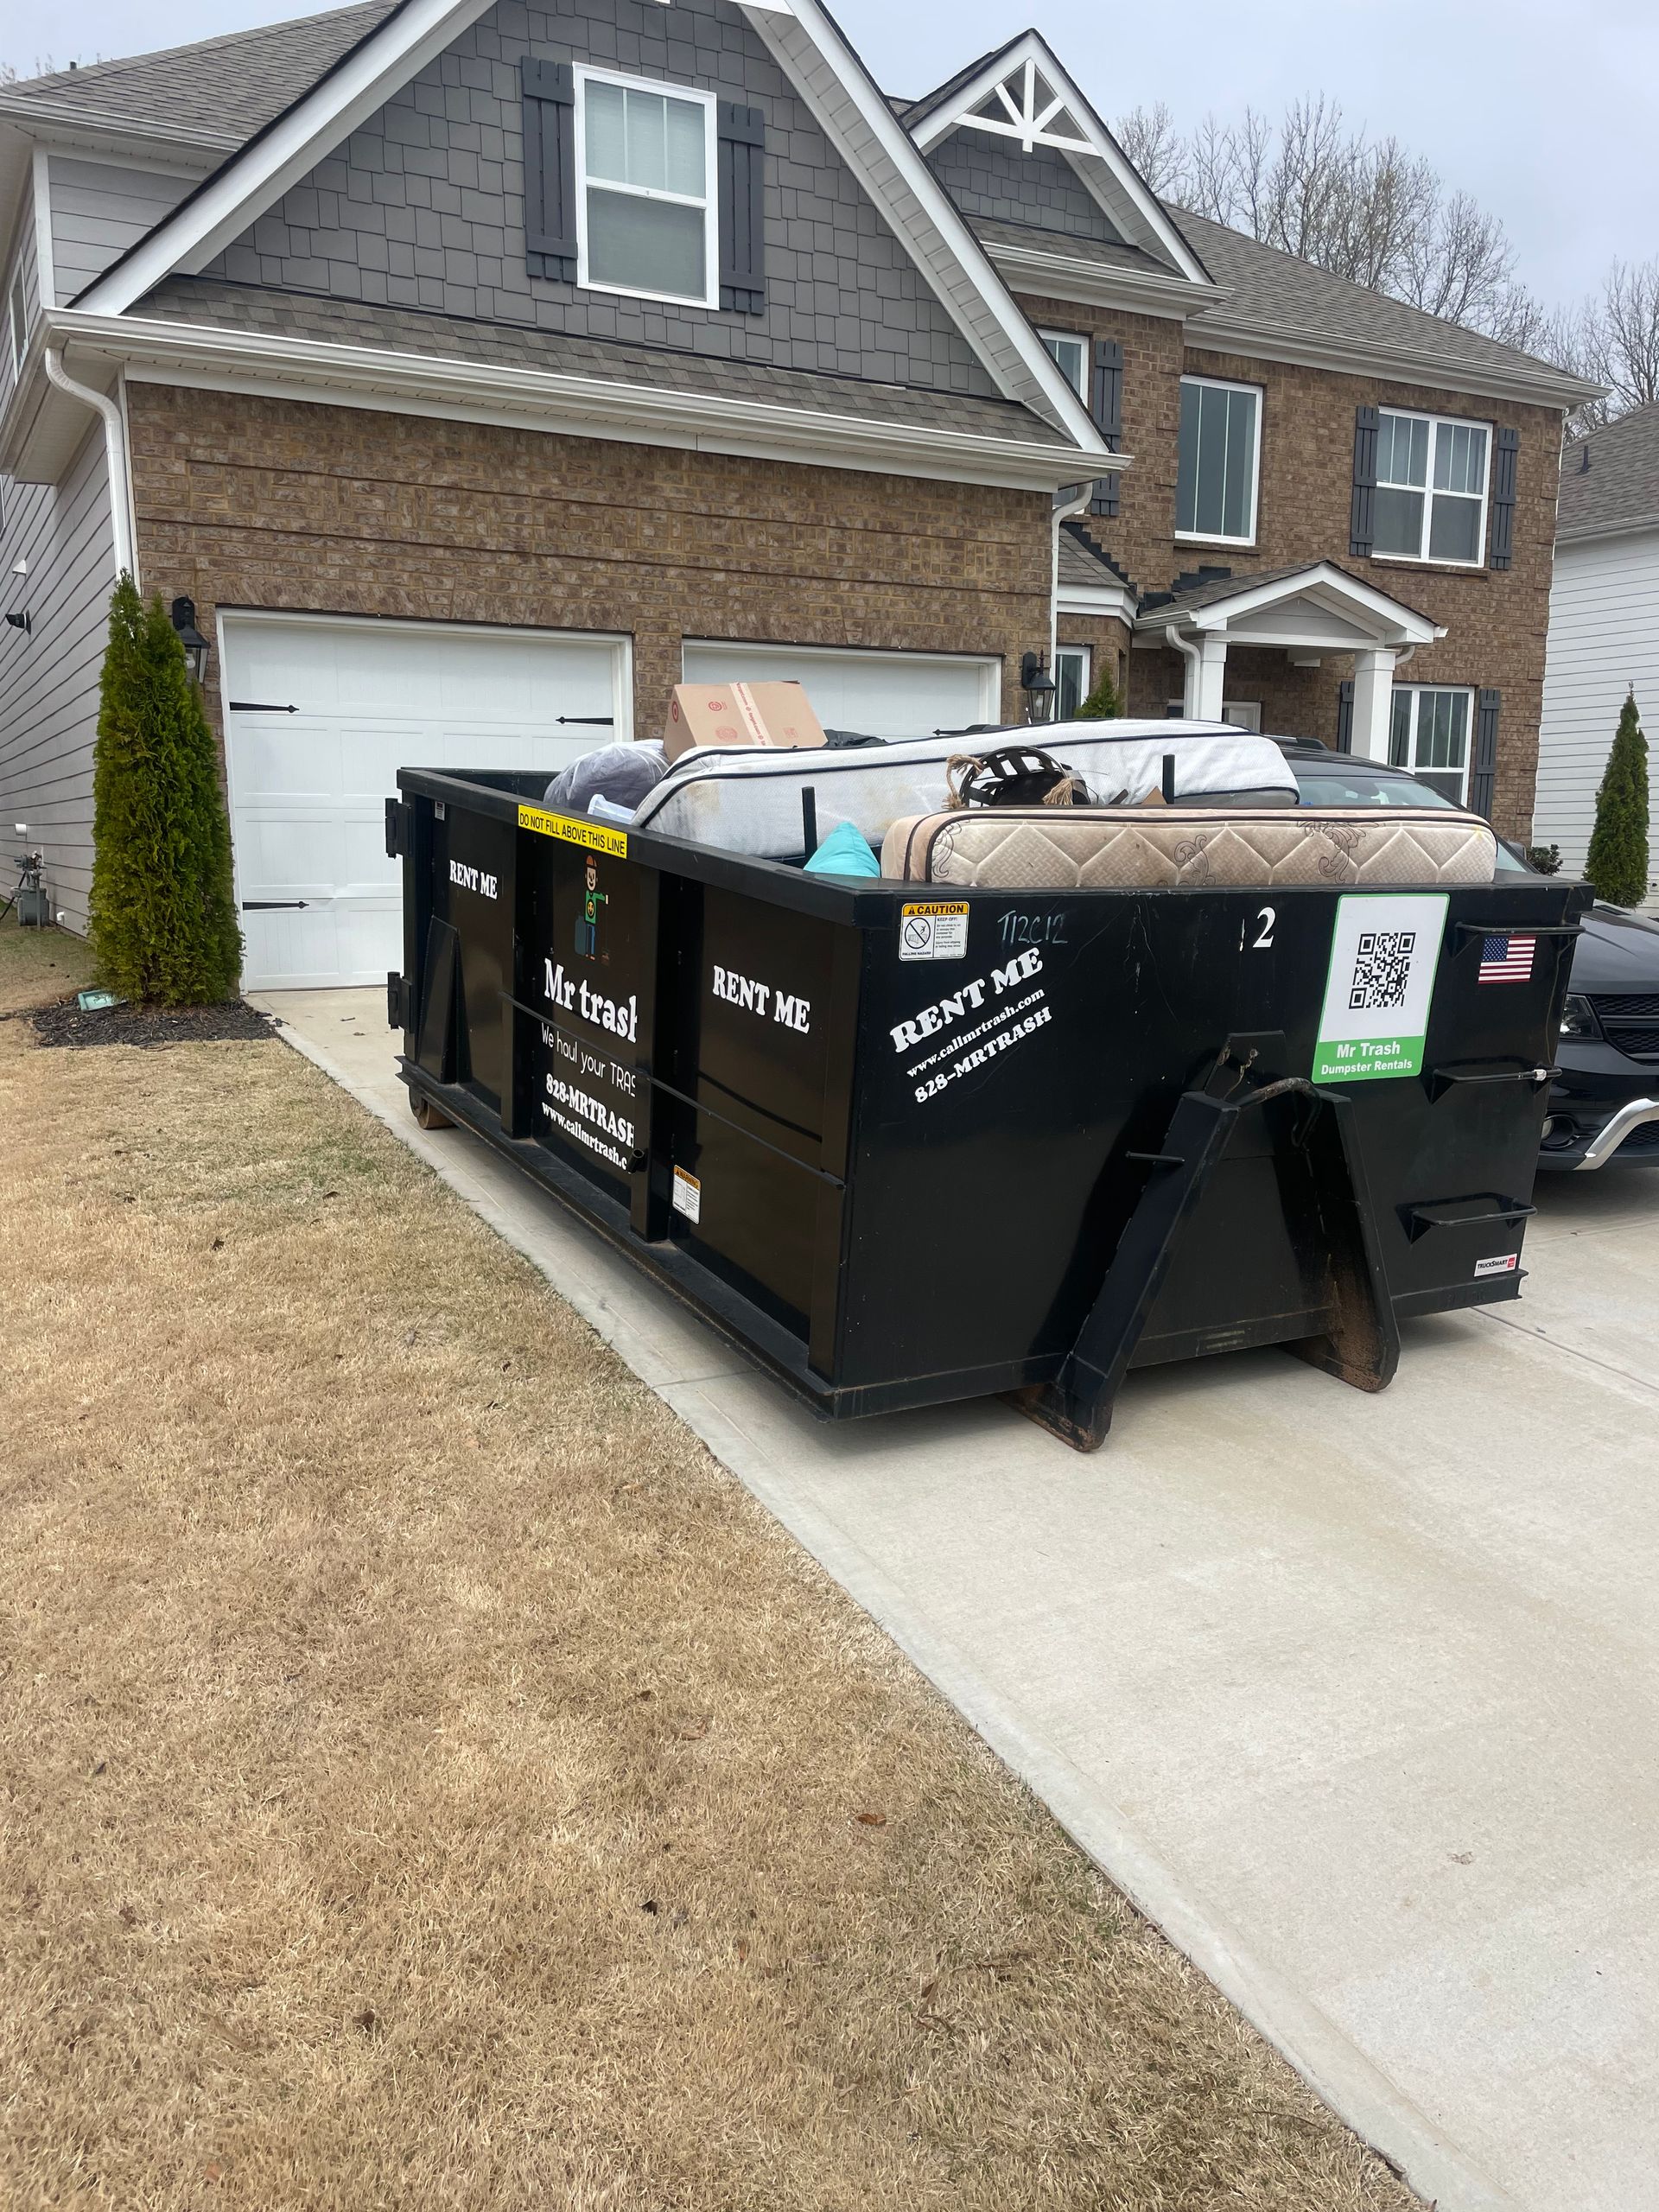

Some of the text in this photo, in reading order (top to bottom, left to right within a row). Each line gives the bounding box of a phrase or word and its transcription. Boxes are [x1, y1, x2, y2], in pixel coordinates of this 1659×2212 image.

[519, 813, 626, 855] DO NOT FILL ABOVE THIS LINE
[449, 859, 498, 899] RENT ME
[917, 905, 964, 915] CAUTION
[544, 957, 575, 1011] Mr
[713, 965, 810, 1033] RENT ME
[889, 947, 1043, 1053] RENT ME
[541, 1022, 636, 1097] We haul your TRAS
[906, 988, 1045, 1077] www.callmrtrash.com
[914, 1006, 1052, 1103] 828-MRTRASH
[1336, 1040, 1401, 1058] Mr Trash
[1320, 1058, 1413, 1076] Dumpster Rentals
[542, 1102, 629, 1171] www.callmrtrash.c
